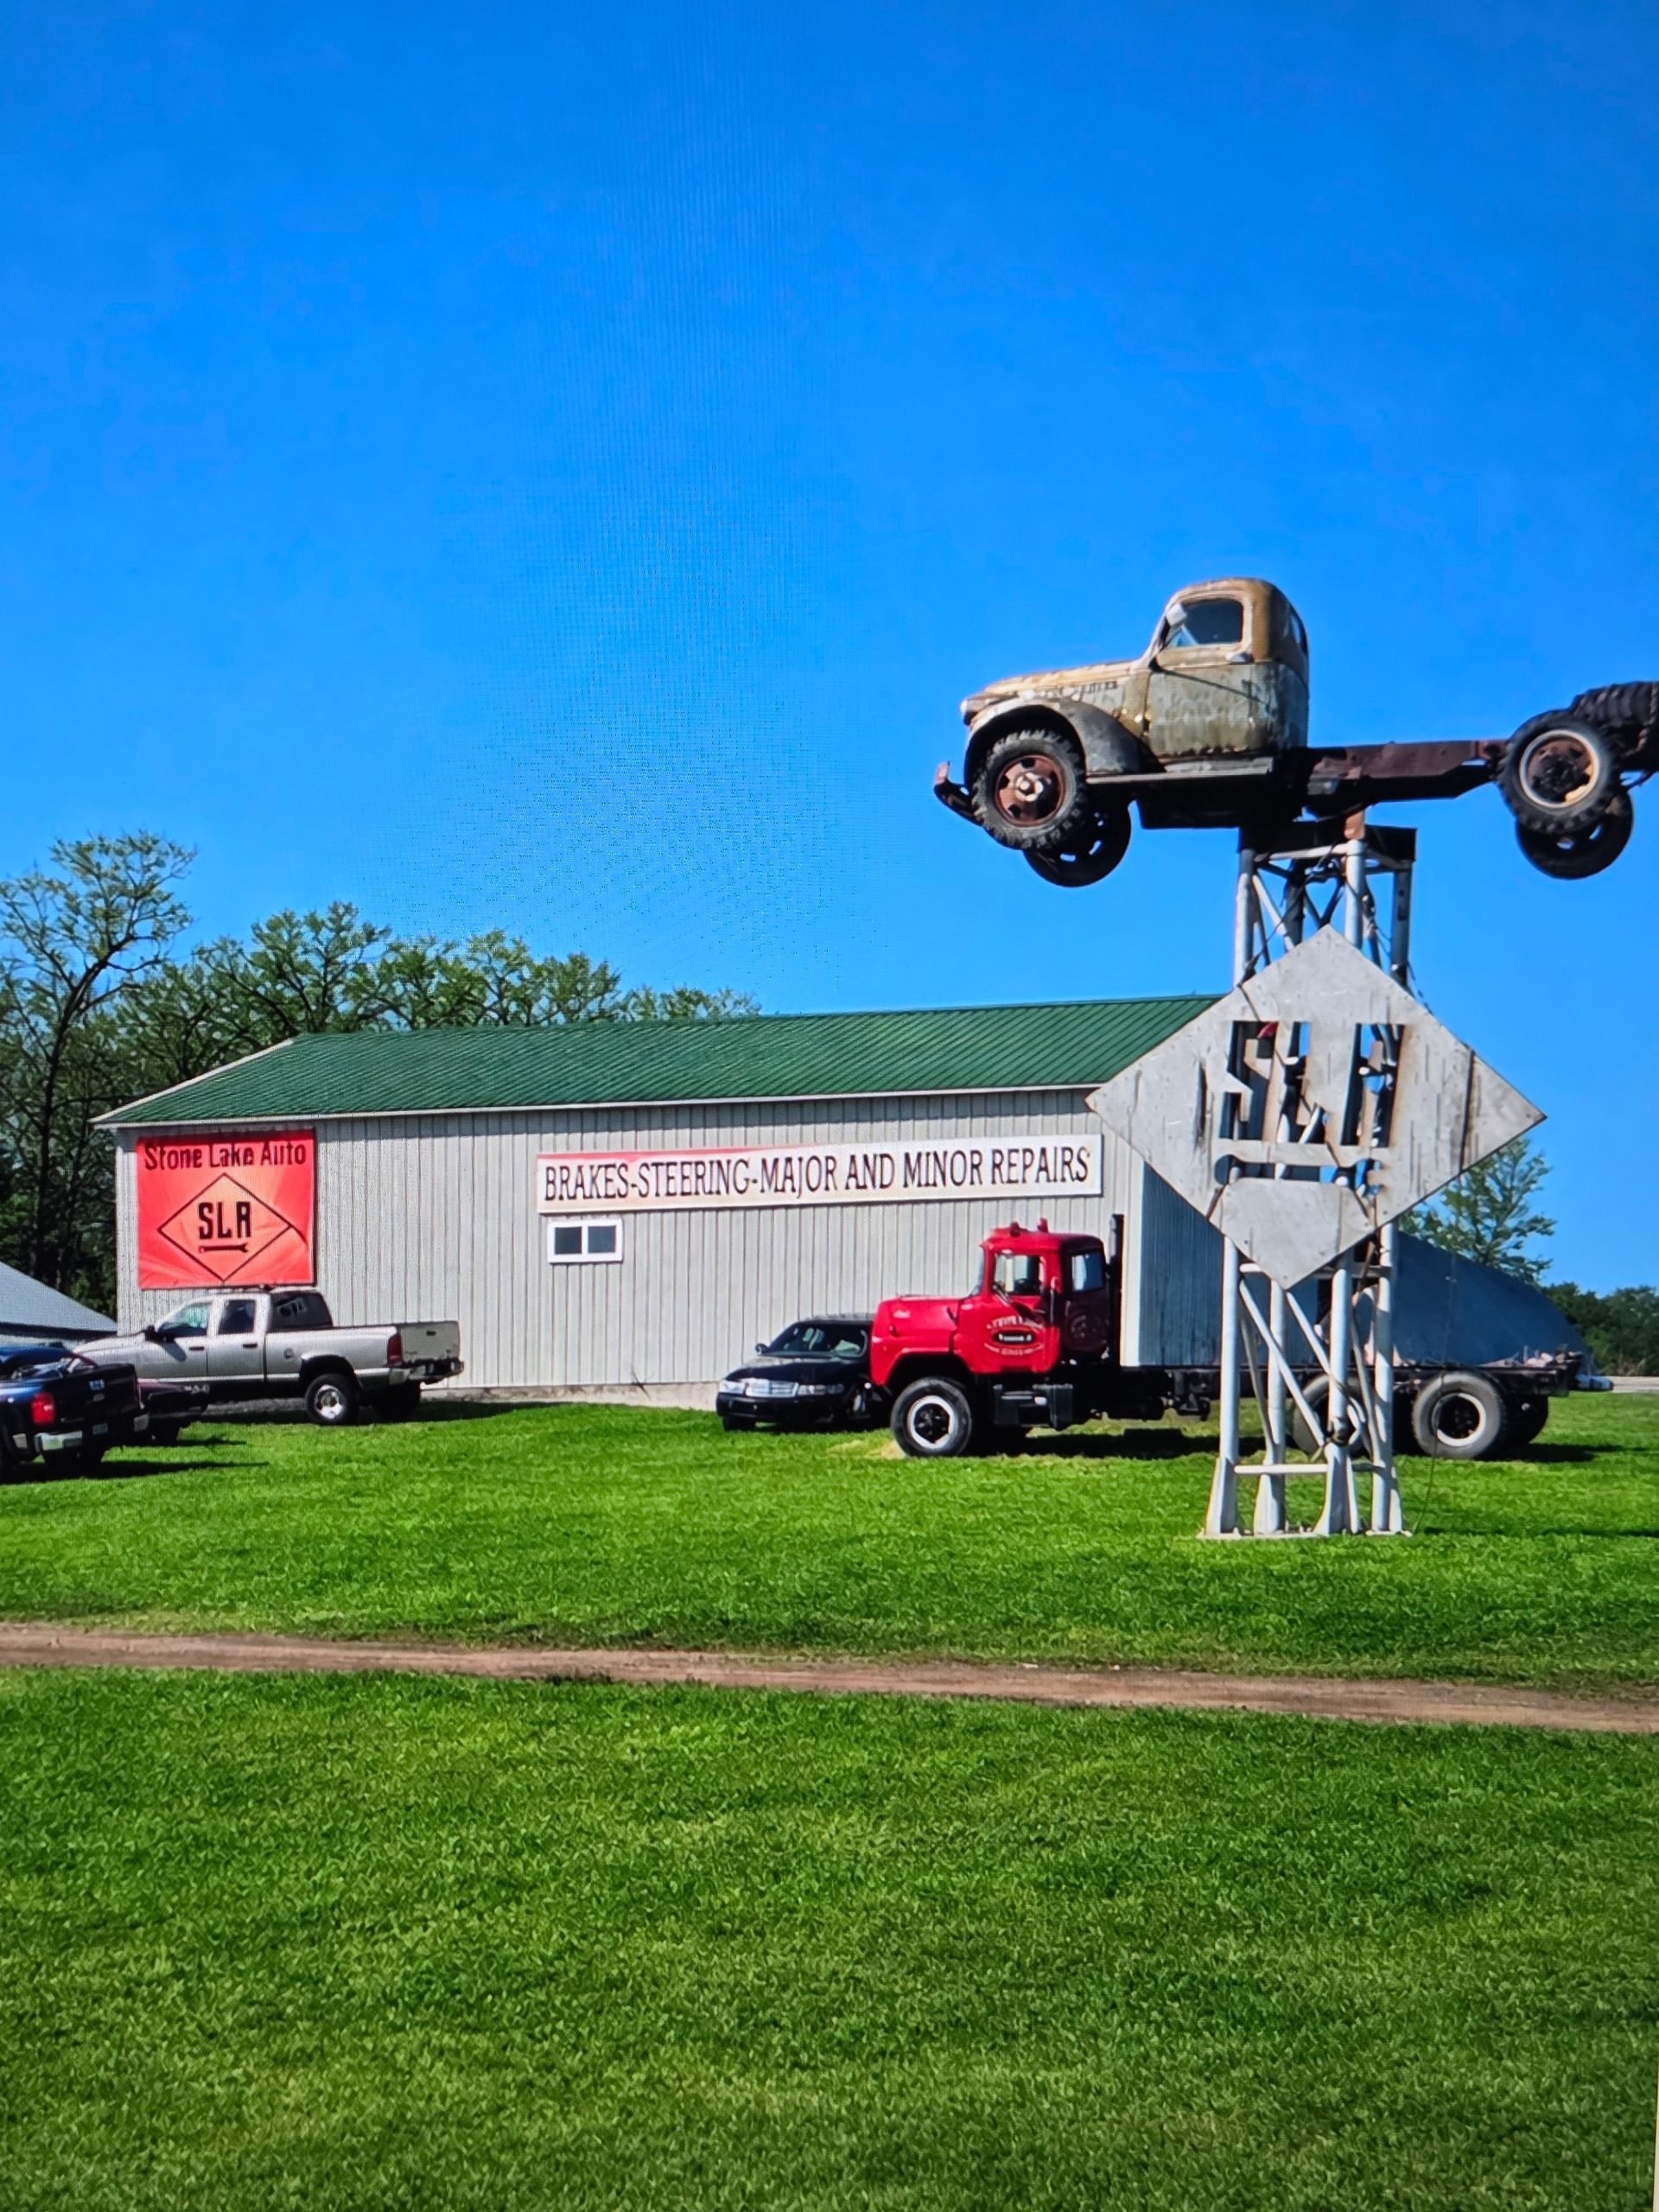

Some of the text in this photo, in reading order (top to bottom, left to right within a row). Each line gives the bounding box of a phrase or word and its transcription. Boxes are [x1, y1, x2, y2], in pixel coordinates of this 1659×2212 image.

[144, 1140, 307, 1171] Stone Lake Auto
[845, 1152, 895, 1191] AND
[903, 1149, 982, 1189] MINOR
[991, 1145, 1090, 1185] REPAIRS
[198, 1201, 251, 1240] SLR
